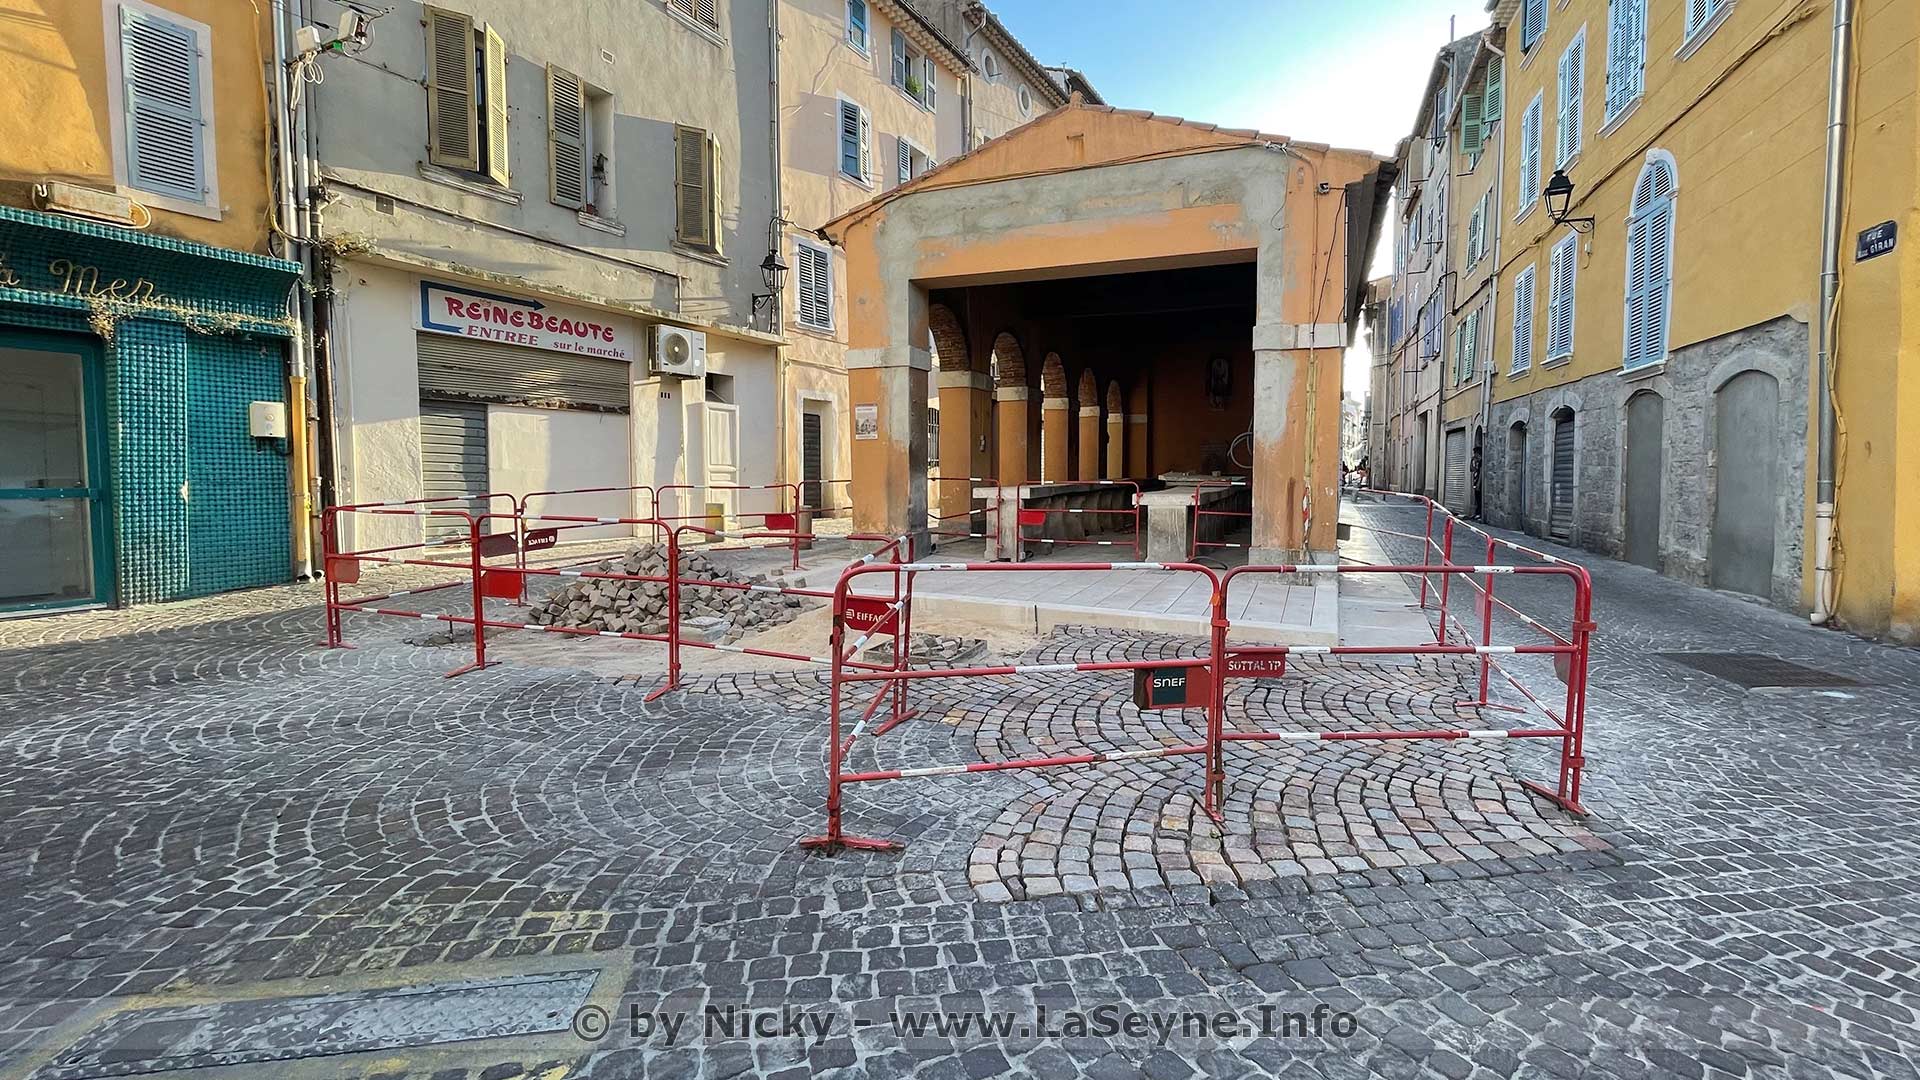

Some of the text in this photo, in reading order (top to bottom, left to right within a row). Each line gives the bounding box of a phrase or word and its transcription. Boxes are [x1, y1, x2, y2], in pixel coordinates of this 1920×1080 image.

[51, 259, 167, 301] Mer
[467, 324, 625, 359] ENTREE sur le marché
[527, 311, 615, 343] BEAUTE
